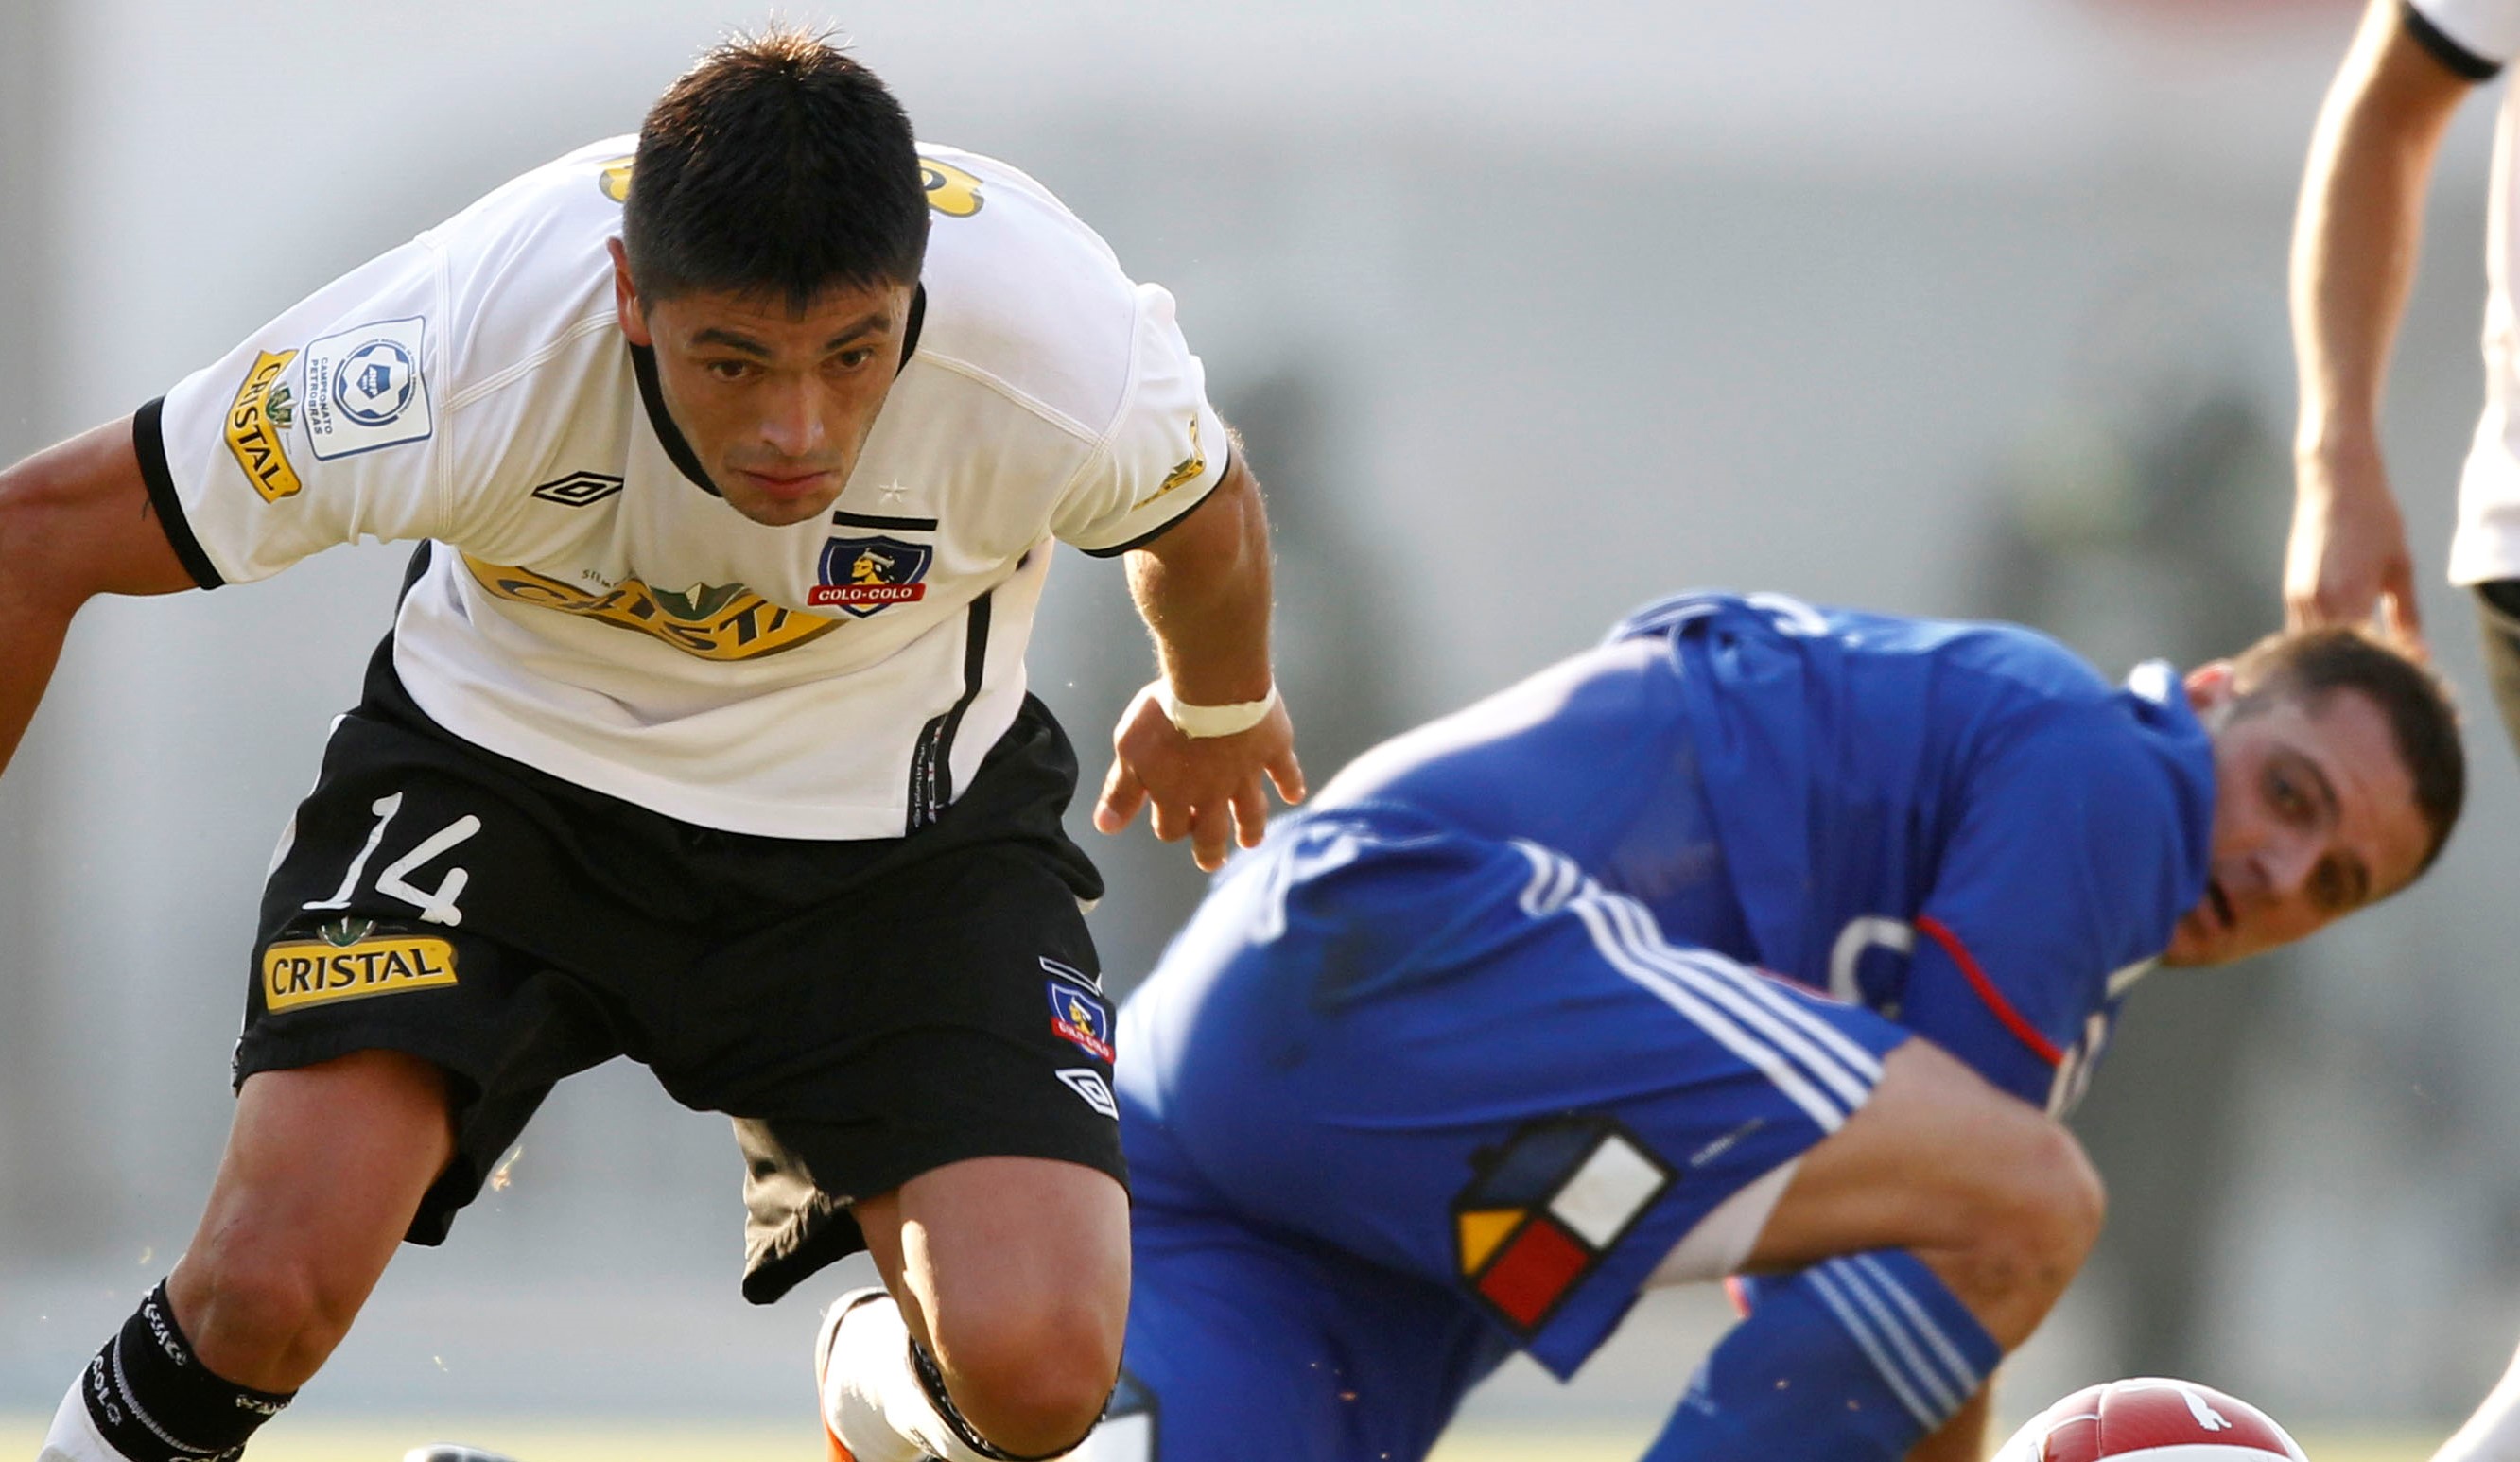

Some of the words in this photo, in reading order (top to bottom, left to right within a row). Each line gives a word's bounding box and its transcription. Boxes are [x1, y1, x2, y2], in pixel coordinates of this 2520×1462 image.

[235, 362, 281, 492] CRISTAL
[308, 358, 323, 435] PETROBRAS
[319, 357, 333, 435] CAMPEONATO
[818, 588, 912, 601] COLO-COLO
[301, 791, 482, 928] 14
[272, 949, 443, 996] CRISTAL
